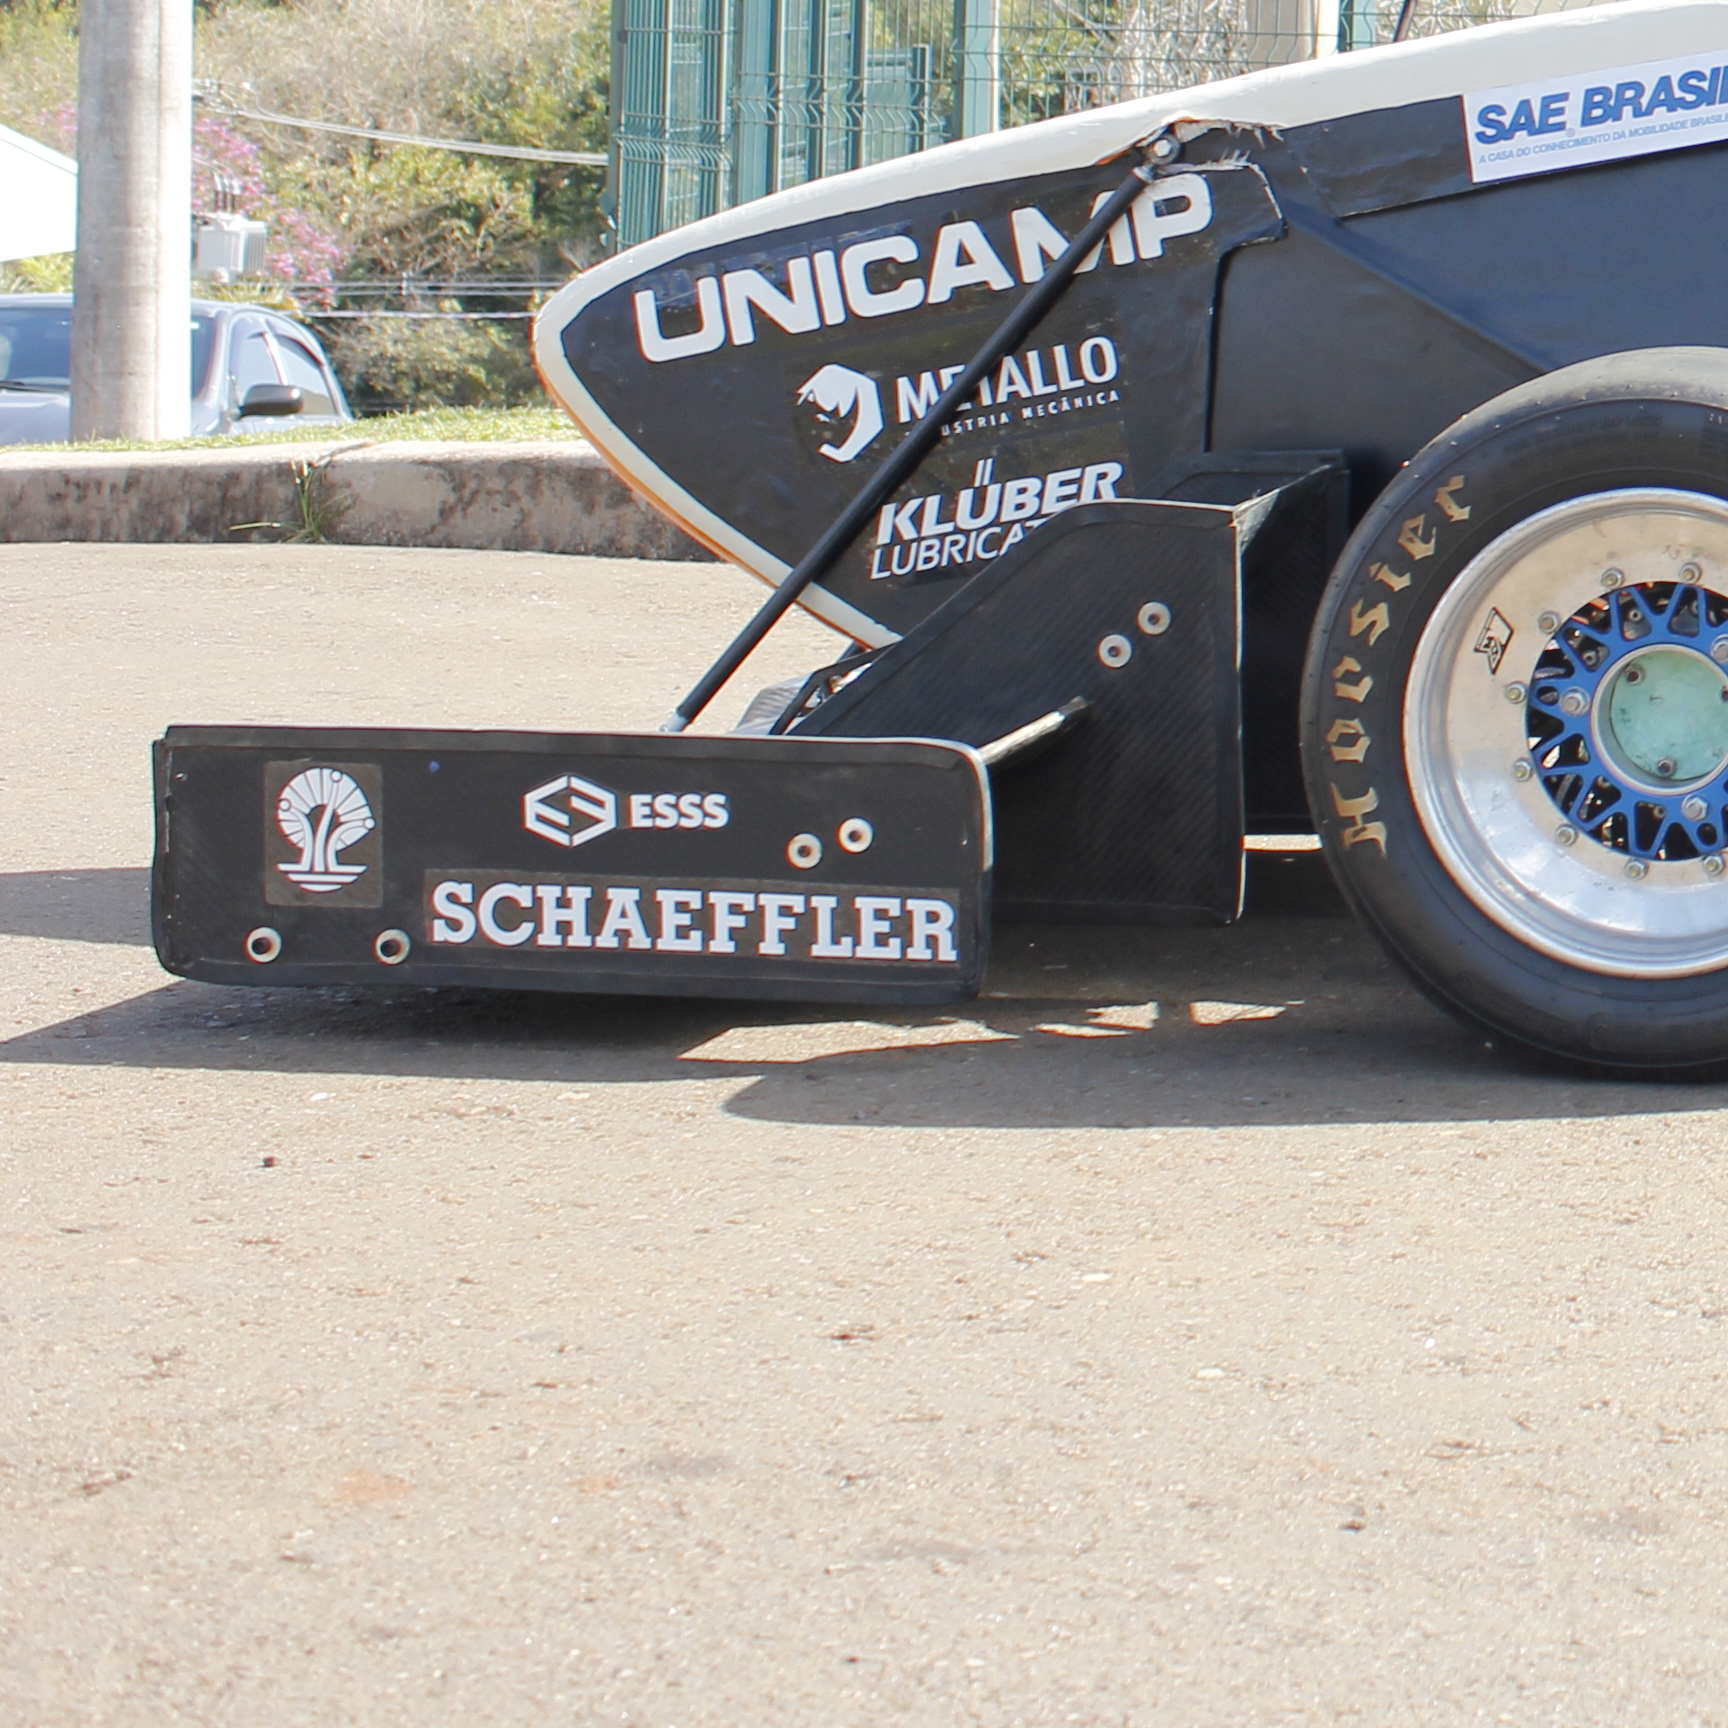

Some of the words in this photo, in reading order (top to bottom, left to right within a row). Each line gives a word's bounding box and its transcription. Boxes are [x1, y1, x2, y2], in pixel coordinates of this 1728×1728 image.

[1473, 92, 1571, 145] SAE
[1478, 154, 1487, 165] A
[1487, 151, 1516, 163] CASA
[1516, 147, 1531, 158] DO
[1532, 132, 1611, 154] CONHECIMENTO
[1612, 130, 1628, 141] DA
[1628, 119, 1689, 138] MOBILIDADE
[633, 174, 1213, 364] UNICAMP
[904, 411, 1010, 438] USTRIA
[875, 457, 1125, 546] KLÜBER
[1328, 474, 1473, 859] Hoosier
[628, 793, 731, 830] ESSS
[430, 879, 960, 964] SCHAEFFLER
